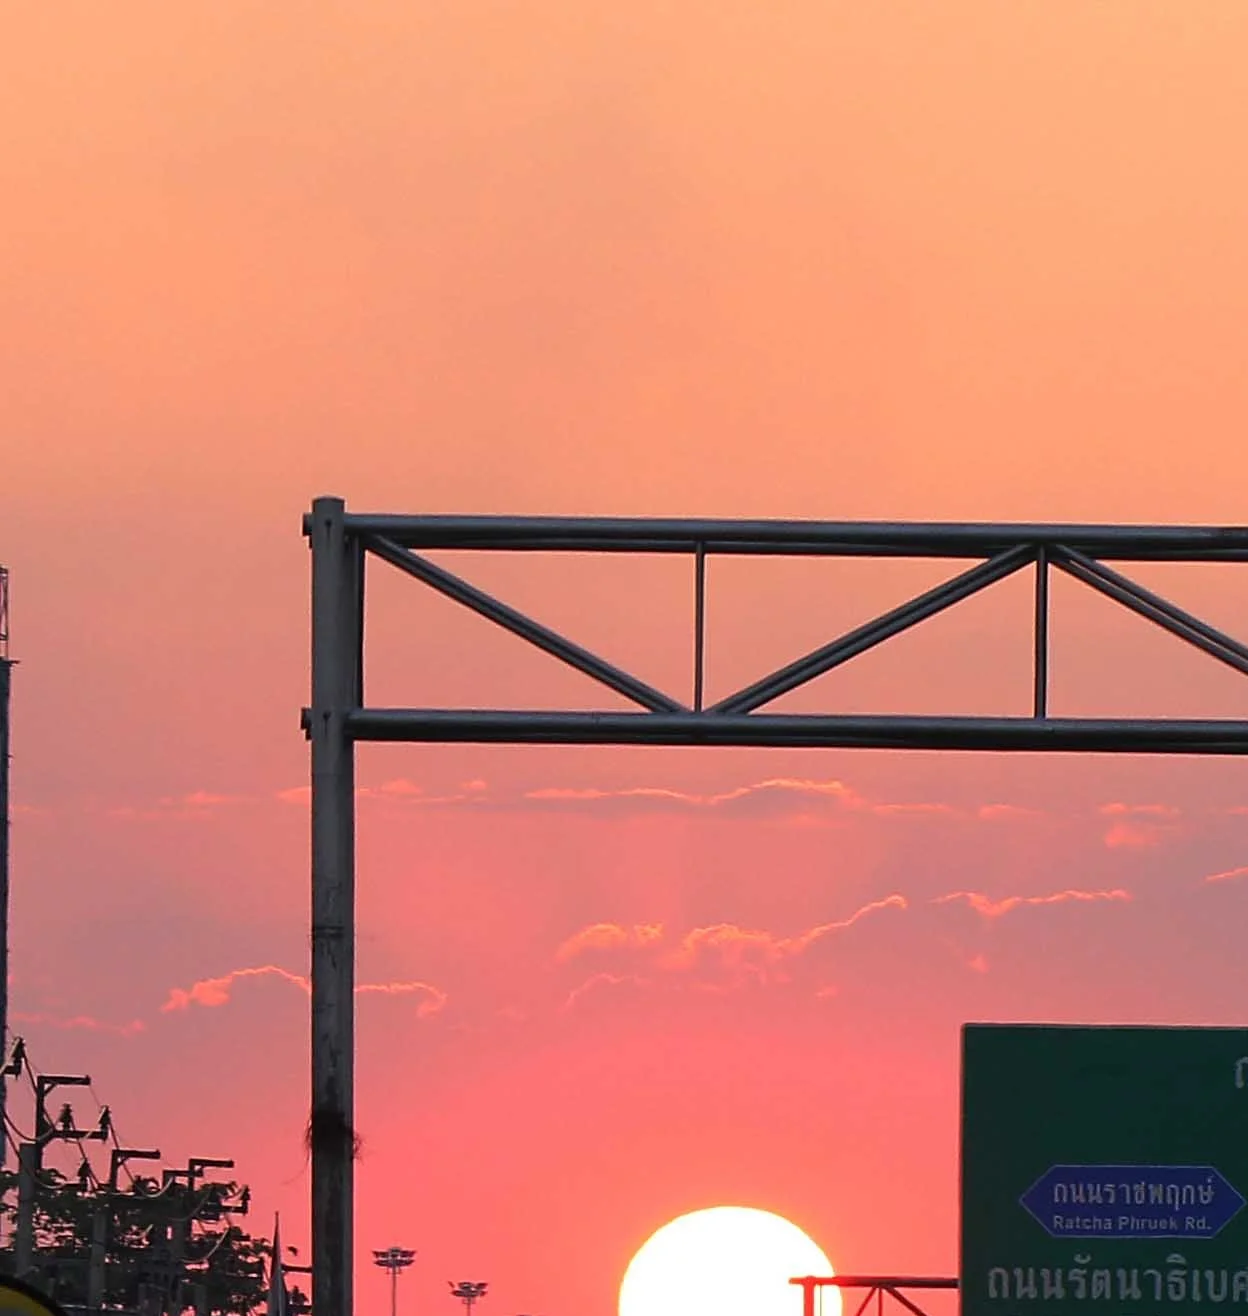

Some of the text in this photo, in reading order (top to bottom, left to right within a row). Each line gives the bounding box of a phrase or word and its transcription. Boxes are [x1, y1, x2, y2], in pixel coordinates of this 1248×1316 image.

[1053, 1174, 1216, 1212] ถนนราชพฤกษ์
[1053, 1215, 1213, 1231] Ratcha Phruek Rd.
